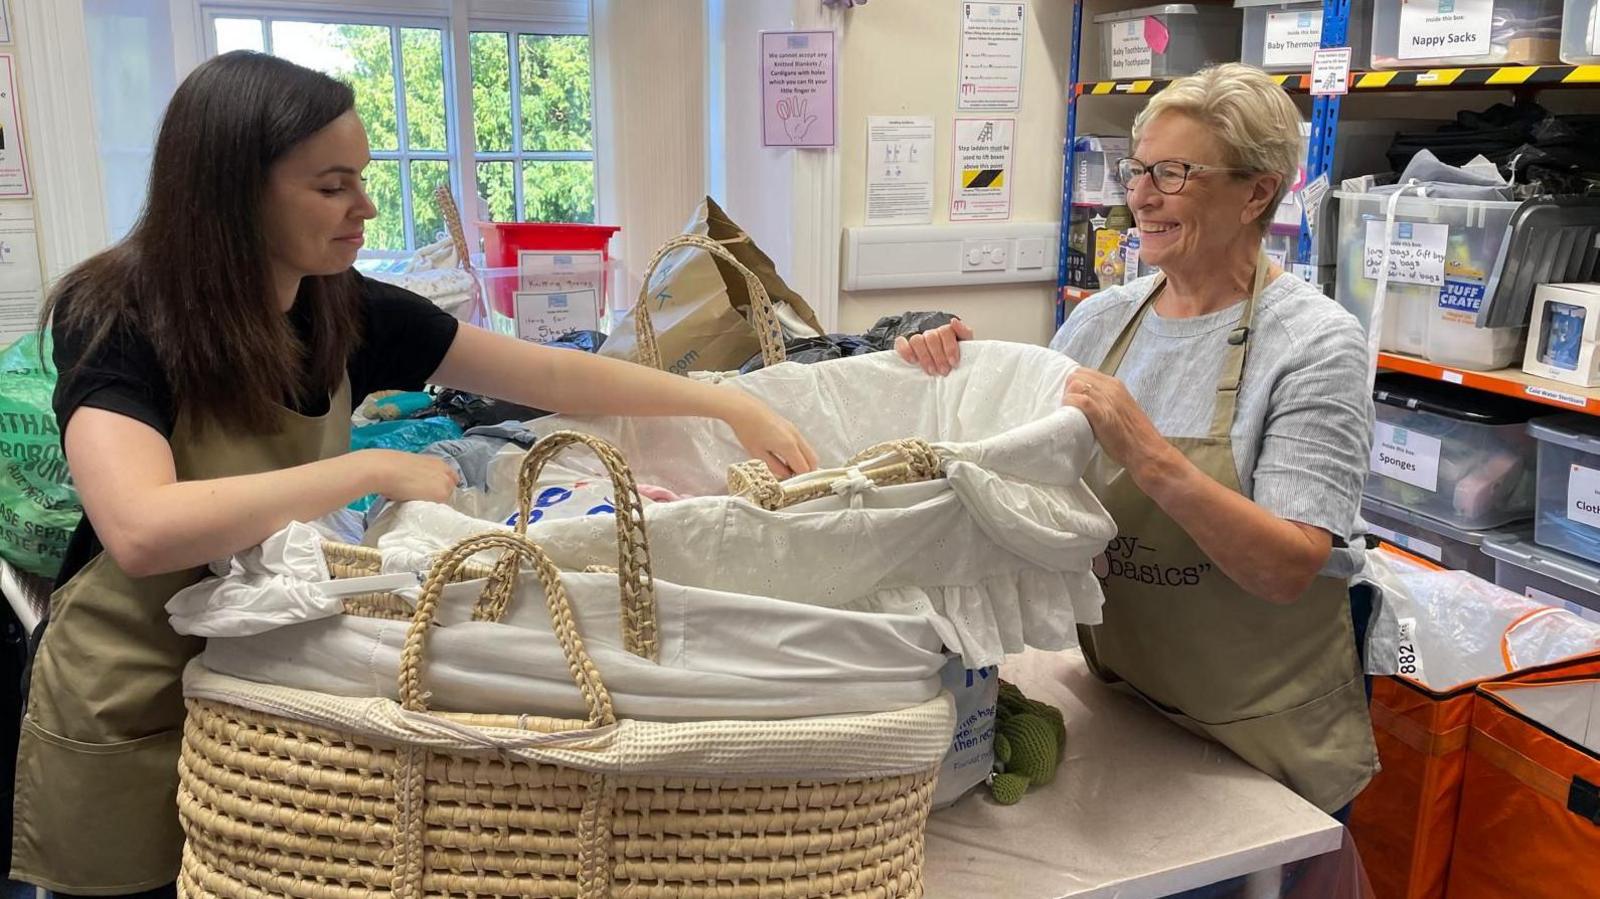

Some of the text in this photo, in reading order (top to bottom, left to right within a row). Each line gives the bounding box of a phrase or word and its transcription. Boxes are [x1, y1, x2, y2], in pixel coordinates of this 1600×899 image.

[1267, 41, 1285, 51] Baby
[1412, 32, 1477, 47] Nappy Sacks
[1113, 47, 1124, 56] Baby
[1113, 58, 1151, 69] Baby Toothpaste
[794, 87, 810, 95] finger
[1447, 284, 1480, 298] TUFF
[1440, 293, 1481, 309] CRATE
[1379, 452, 1416, 472] Sponges
[1399, 643, 1417, 674] 882
[953, 737, 979, 753] Then
